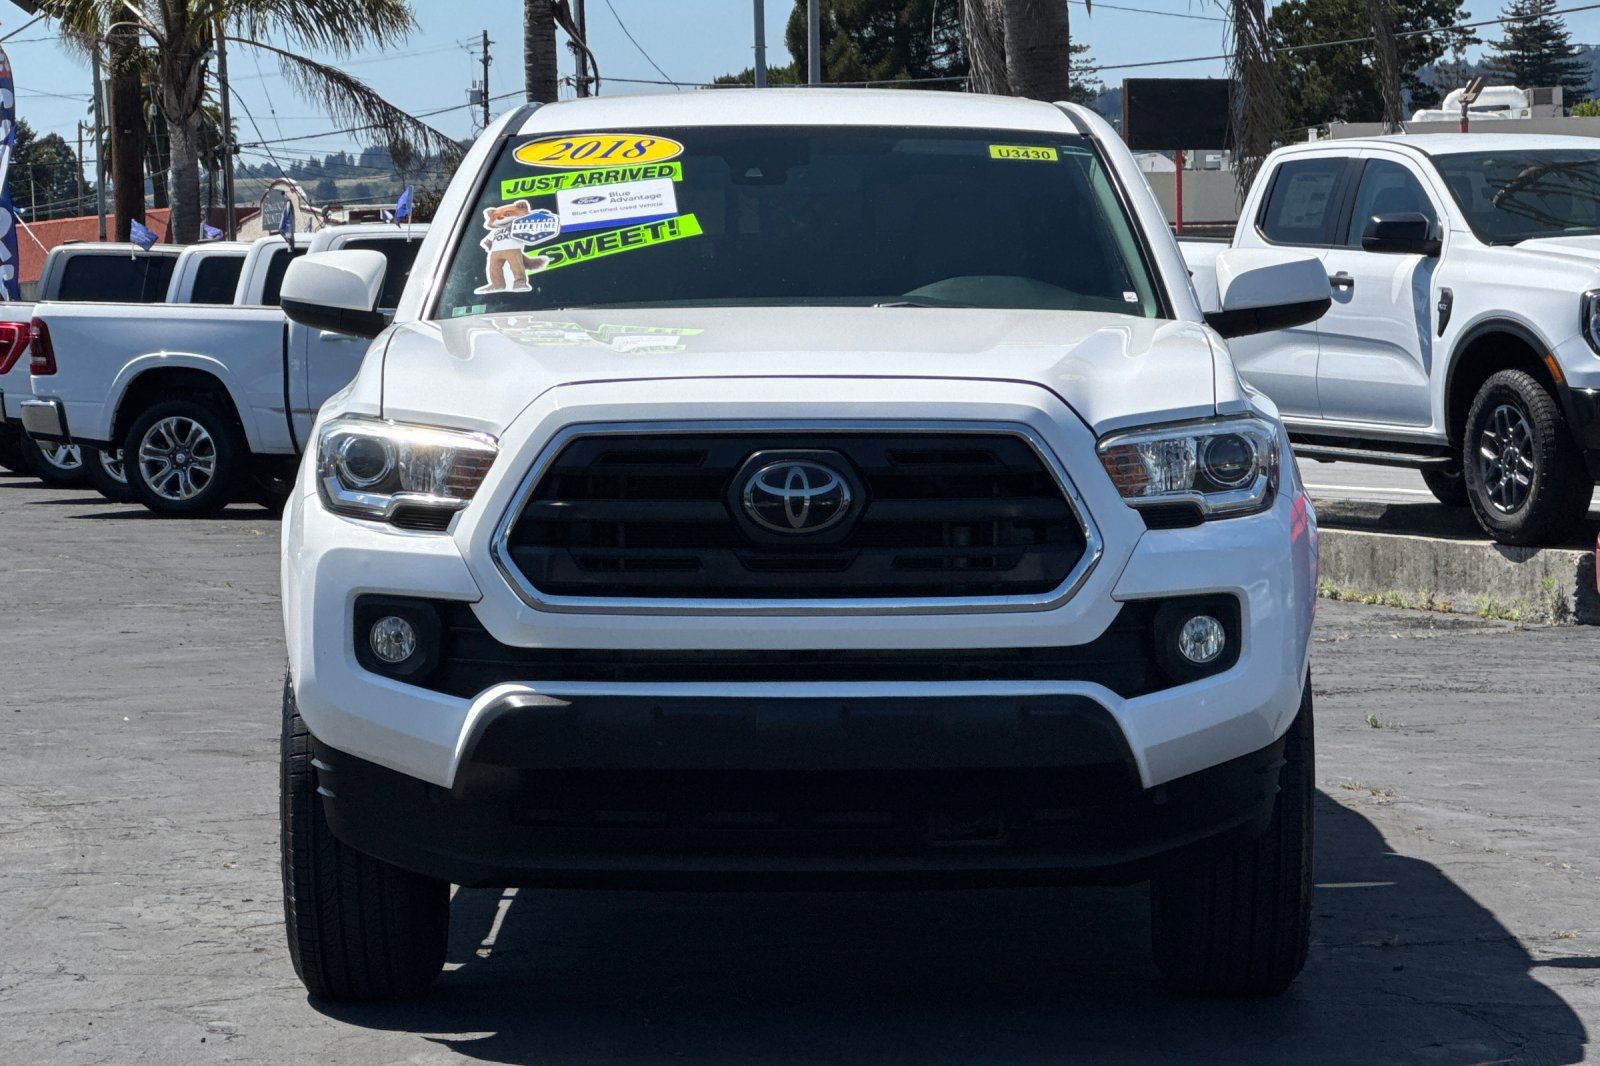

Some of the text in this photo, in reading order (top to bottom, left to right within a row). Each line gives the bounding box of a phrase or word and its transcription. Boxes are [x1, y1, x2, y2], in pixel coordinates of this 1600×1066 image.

[539, 139, 656, 161] 2018
[998, 149, 1051, 159] U3430
[506, 164, 677, 195] JUST ARRIVED
[609, 193, 662, 204] Advantage
[537, 218, 677, 267] SWEET!
